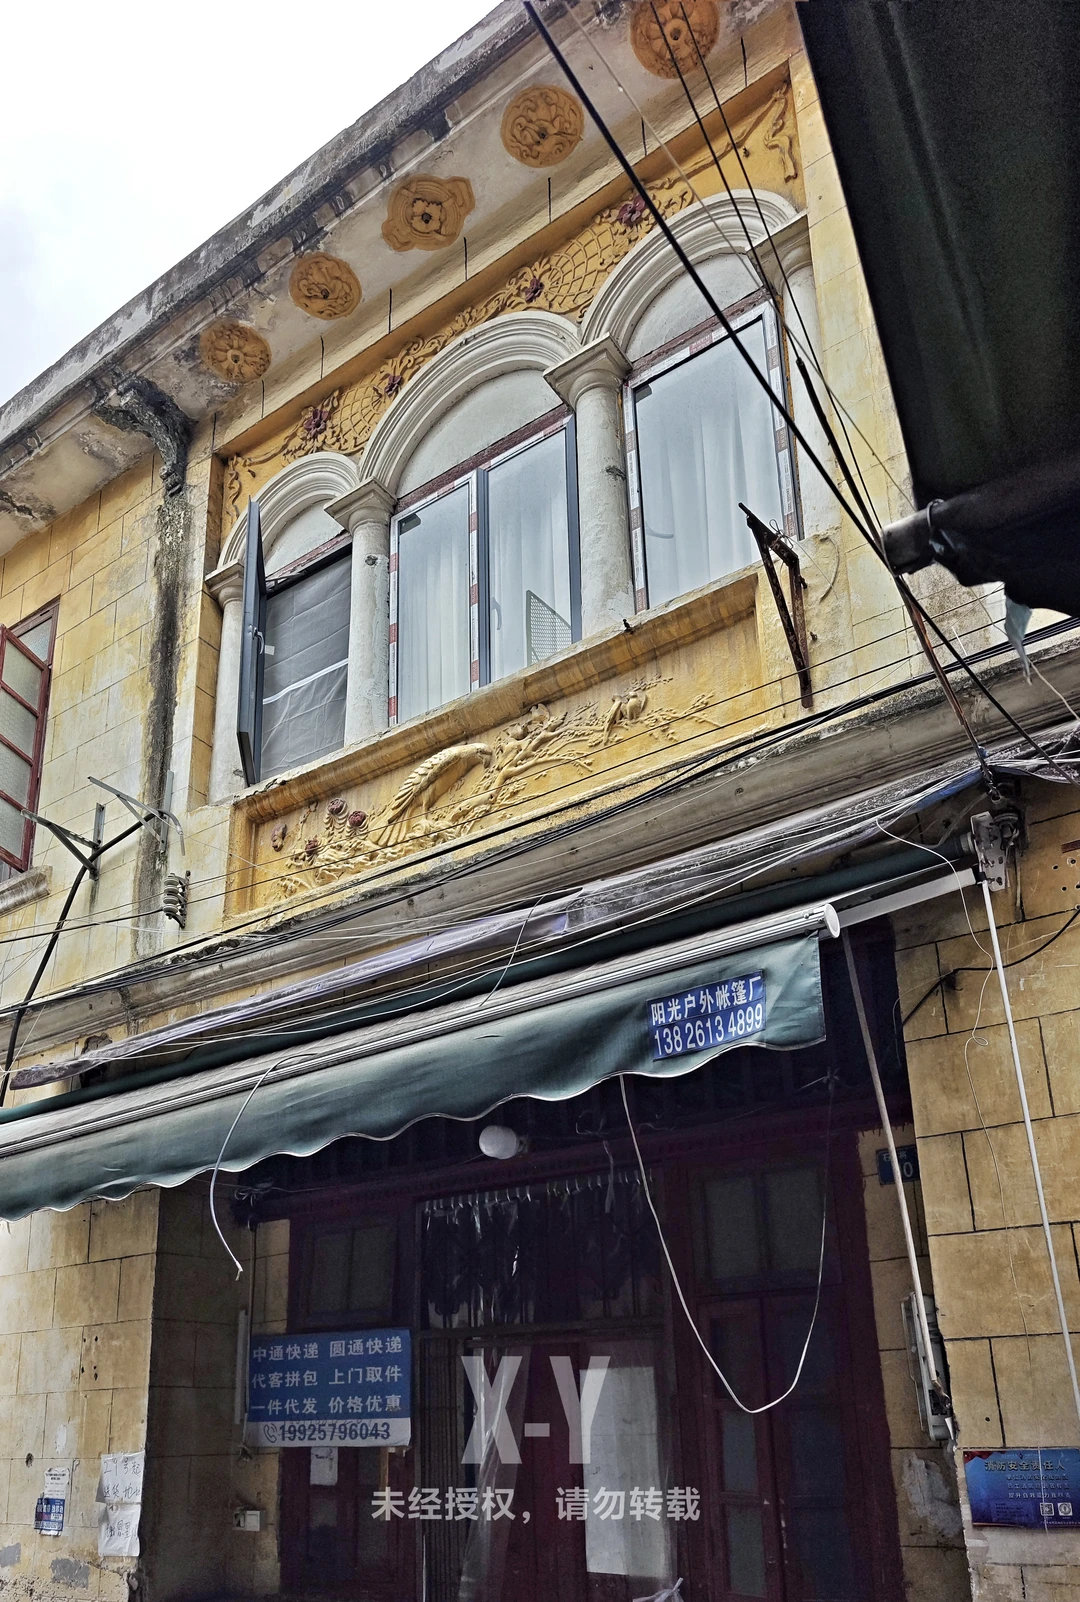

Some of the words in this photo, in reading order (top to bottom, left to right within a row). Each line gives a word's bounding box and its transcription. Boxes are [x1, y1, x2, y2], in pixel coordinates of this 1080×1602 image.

[651, 976, 762, 1025] 阳光户外帐篷厂
[654, 1025, 683, 1055] 138
[685, 1015, 725, 1049] 2613
[728, 1003, 763, 1037] 4899
[252, 1342, 319, 1362] 中通快递
[329, 1335, 402, 1358] 圆通快递
[252, 1370, 318, 1389] 代客拼包
[328, 1365, 402, 1385] 上门取件
[251, 1397, 318, 1415] 一件代发
[328, 1394, 402, 1414] 价格优惠
[279, 1422, 391, 1441] 19925796043
[984, 1460, 1066, 1471] 消防安全责任人
